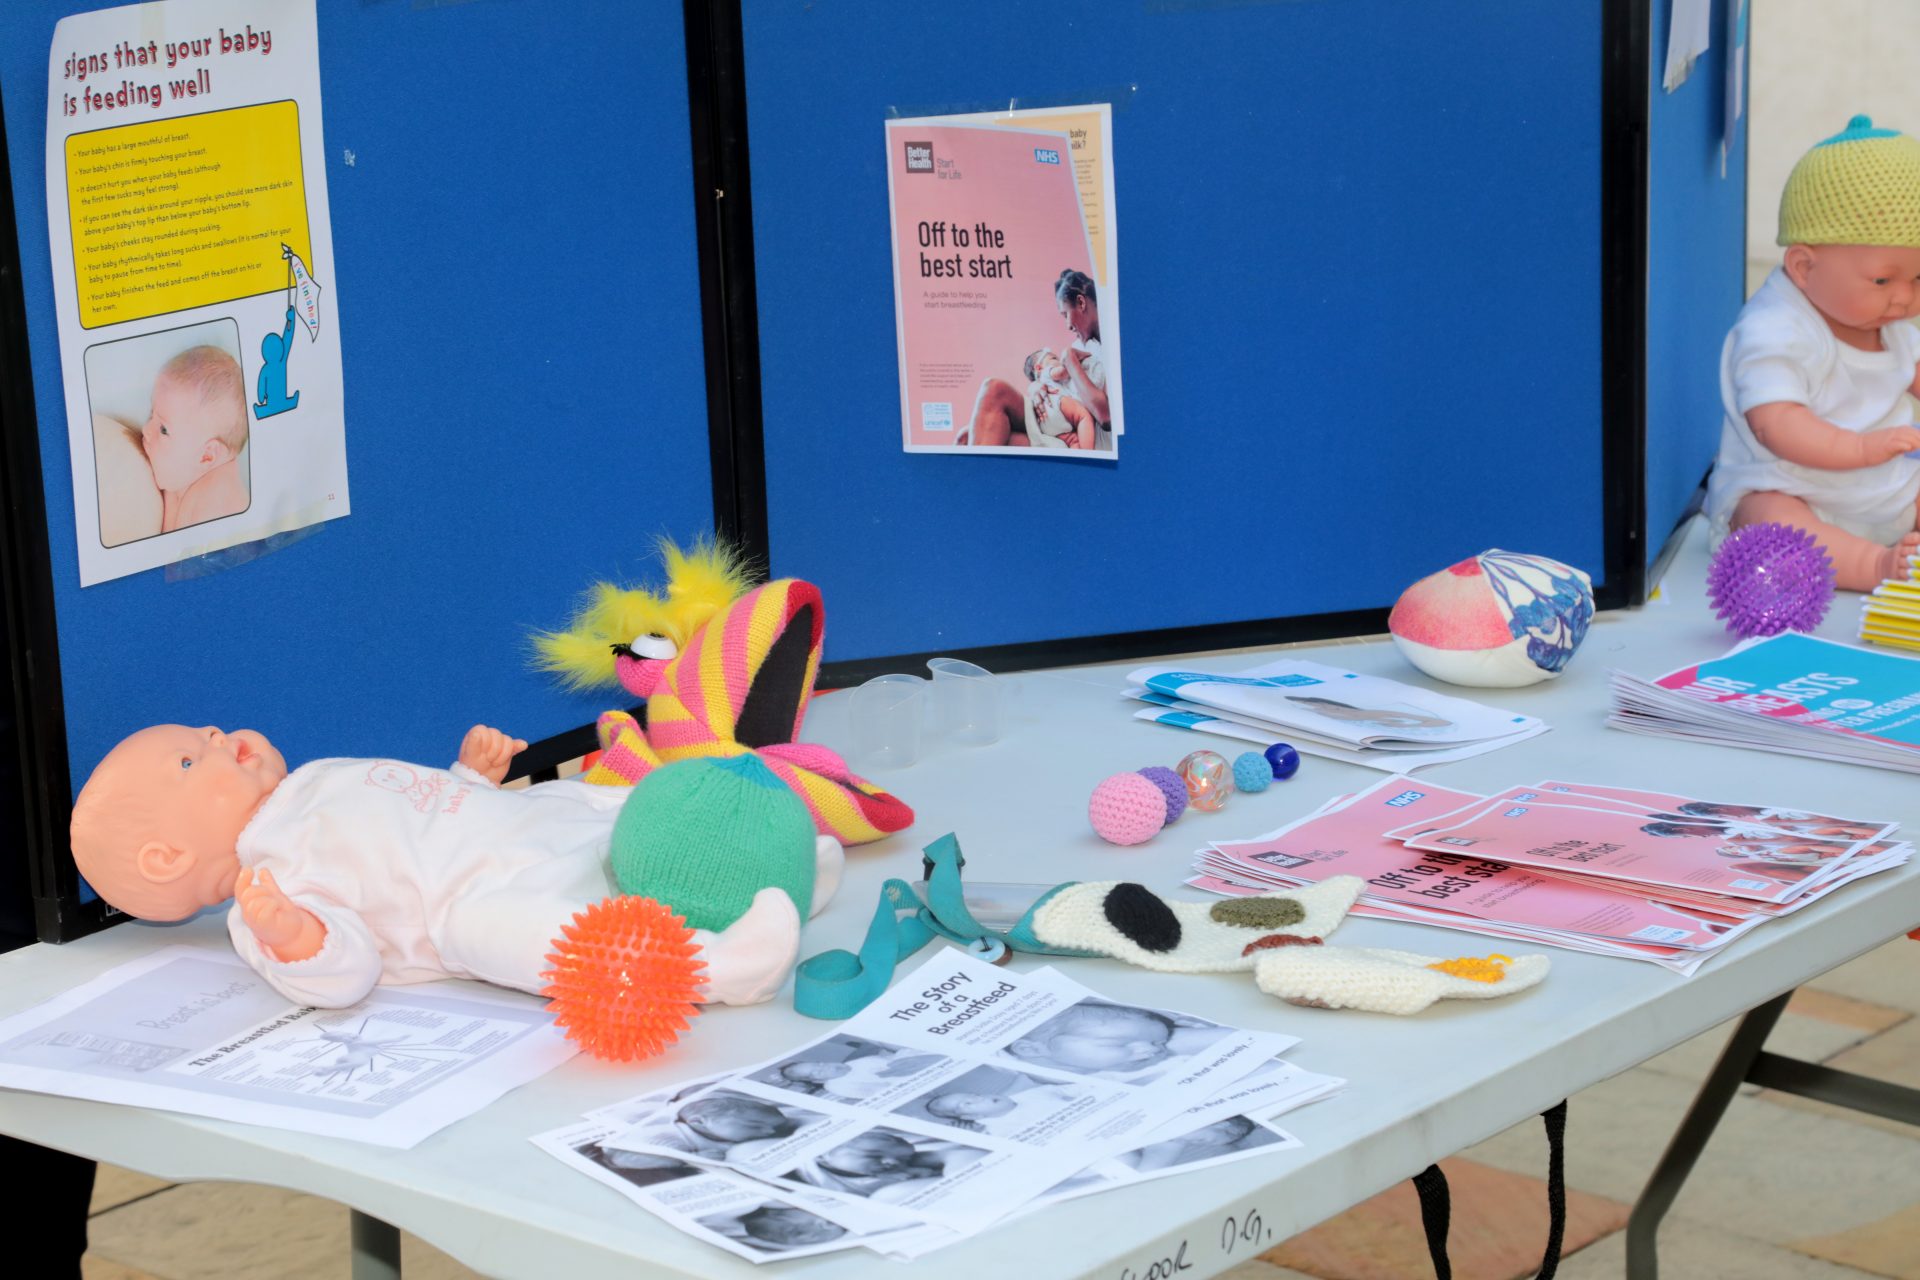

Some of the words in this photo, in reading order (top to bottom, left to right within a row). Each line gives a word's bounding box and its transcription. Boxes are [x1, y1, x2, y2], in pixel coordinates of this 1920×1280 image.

[65, 50, 108, 81] signs
[114, 41, 157, 69] that
[166, 36, 212, 68] your
[219, 25, 272, 54] baby
[64, 93, 76, 116] is
[84, 80, 161, 113] feeding
[169, 69, 211, 99] well
[122, 142, 136, 150] large
[138, 137, 163, 147] mouthful
[1070, 129, 1087, 140] baby
[131, 158, 147, 166] firmly
[149, 154, 173, 164] touching
[175, 152, 187, 161] your
[1036, 151, 1058, 163] NHS
[121, 179, 131, 188] you
[149, 174, 161, 182] your
[163, 170, 176, 178] baby
[178, 167, 193, 175] feeds
[89, 215, 99, 224] you
[160, 201, 179, 209] around
[181, 199, 193, 207] your
[226, 189, 243, 197] should
[117, 191, 132, 199] sucks
[84, 228, 101, 236] above
[103, 226, 115, 234] your
[156, 215, 169, 223] than
[171, 212, 187, 220] below
[188, 210, 201, 218] your
[222, 202, 241, 211] bottom
[121, 238, 140, 247] cheeks
[155, 230, 178, 240] rounded
[180, 227, 198, 236] during
[918, 221, 946, 247] Off
[951, 223, 969, 247] to
[975, 222, 1004, 248] the
[103, 261, 117, 269] baby
[119, 253, 154, 265] rhythmically
[156, 250, 170, 258] takes
[172, 246, 184, 254] long
[186, 244, 200, 252] sucks
[213, 237, 237, 247] swallows
[251, 232, 269, 240] normal
[279, 227, 291, 236] your
[112, 271, 128, 279] pause
[130, 268, 144, 276] from
[920, 252, 963, 277] best
[969, 254, 1013, 278] start
[106, 290, 120, 298] baby
[122, 285, 144, 294] finishes
[183, 275, 200, 283] comes
[222, 266, 238, 276] breast
[1729, 672, 1860, 713] REASTS
[1389, 790, 1424, 807] NHS
[1400, 864, 1444, 876] to
[1421, 853, 1468, 866] th
[1367, 872, 1421, 890] Off
[1408, 875, 1481, 899] best
[1464, 860, 1511, 878] sta
[890, 1001, 929, 1021] The
[922, 972, 972, 1001] Story
[927, 981, 1017, 1035] Breastfeed
[938, 1000, 957, 1013] of
[954, 994, 969, 1002] a
[188, 1053, 223, 1066] The
[283, 1006, 317, 1020] Bab
